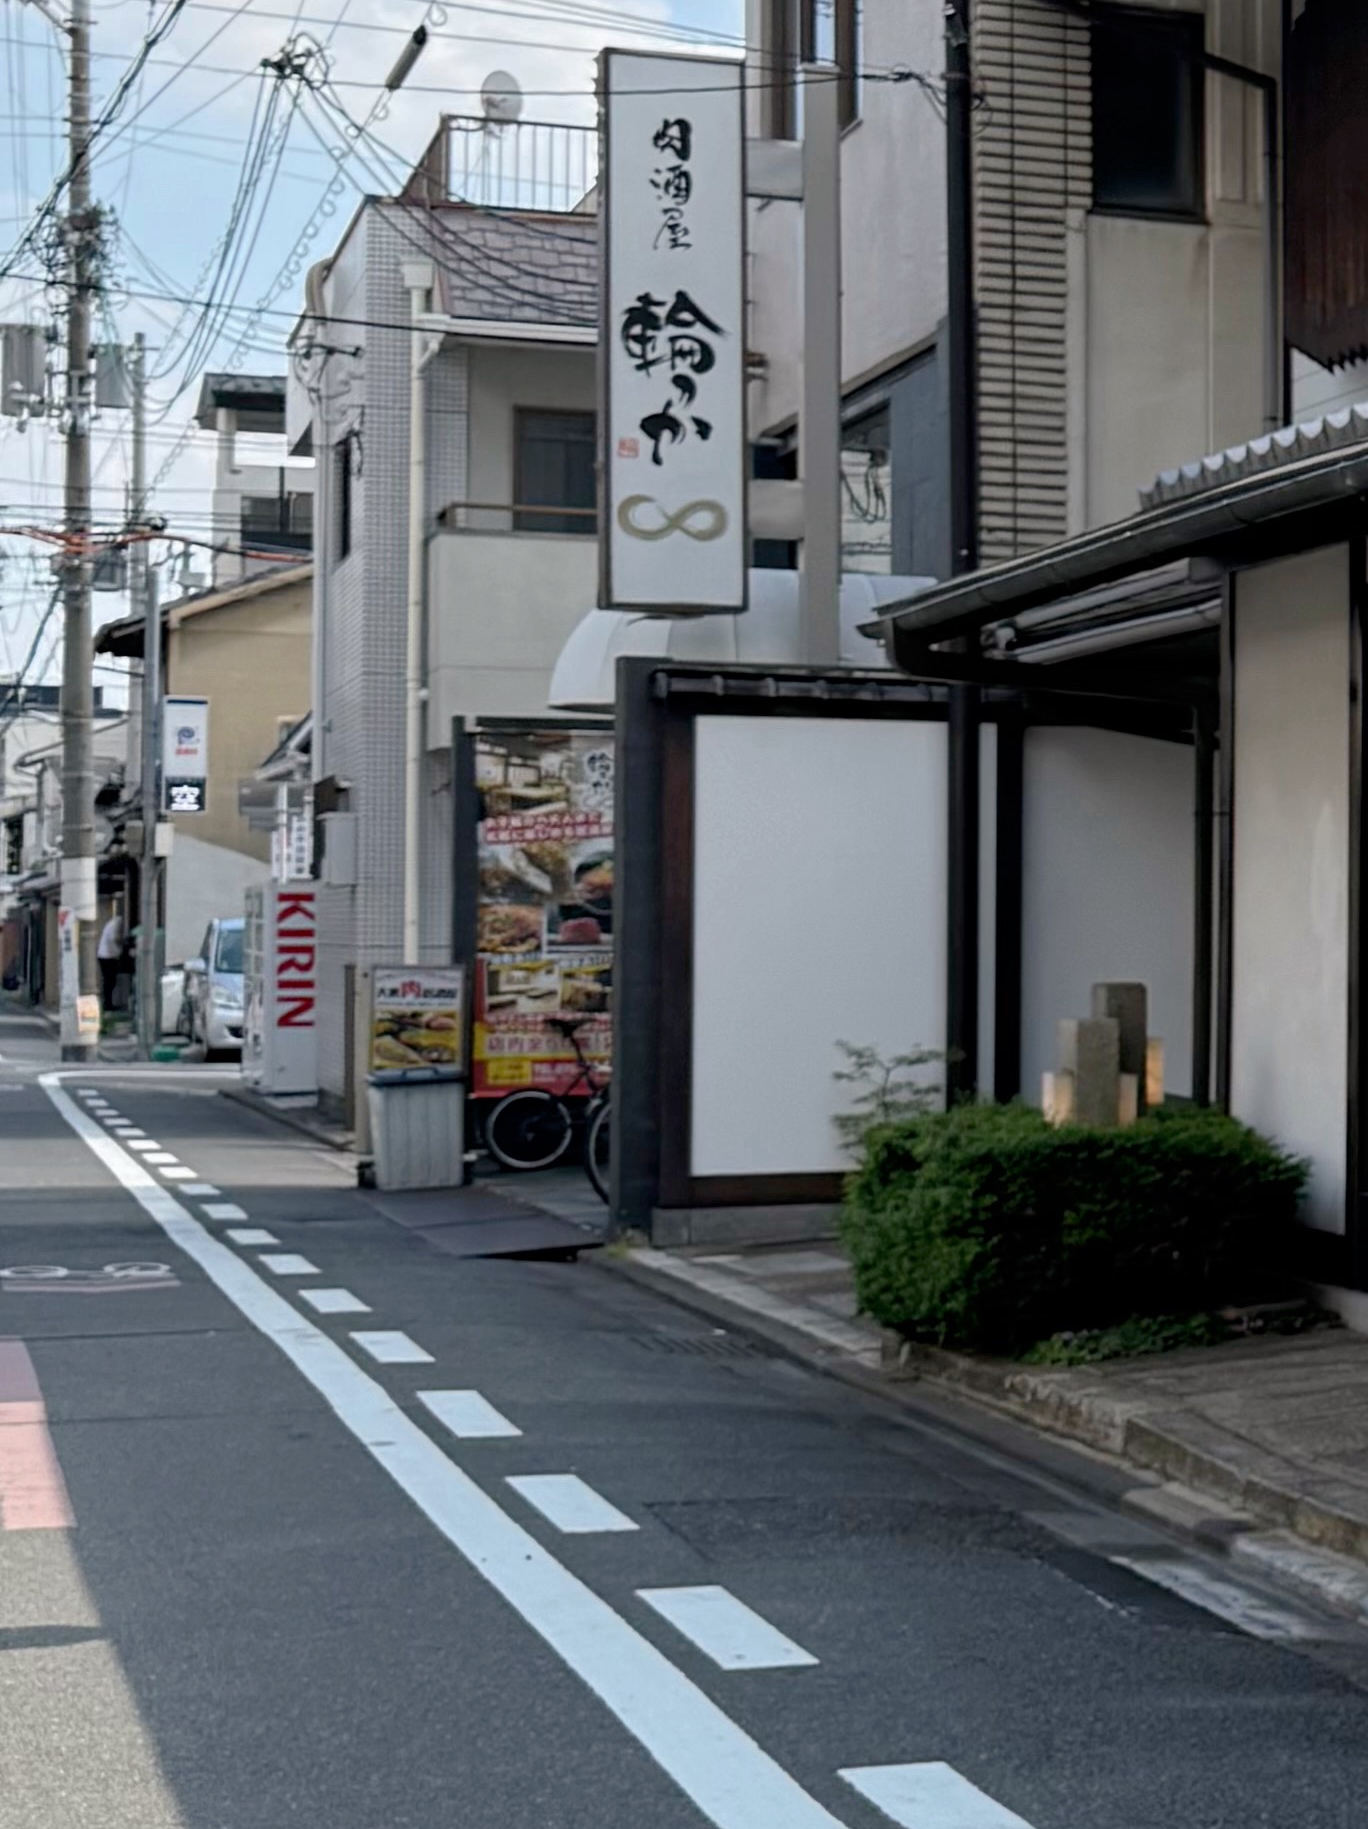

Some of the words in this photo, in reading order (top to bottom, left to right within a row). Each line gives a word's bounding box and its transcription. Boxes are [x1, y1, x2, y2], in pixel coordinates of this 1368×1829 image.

[620, 289, 731, 466] 輪っか
[277, 893, 316, 1028] KIRIN
